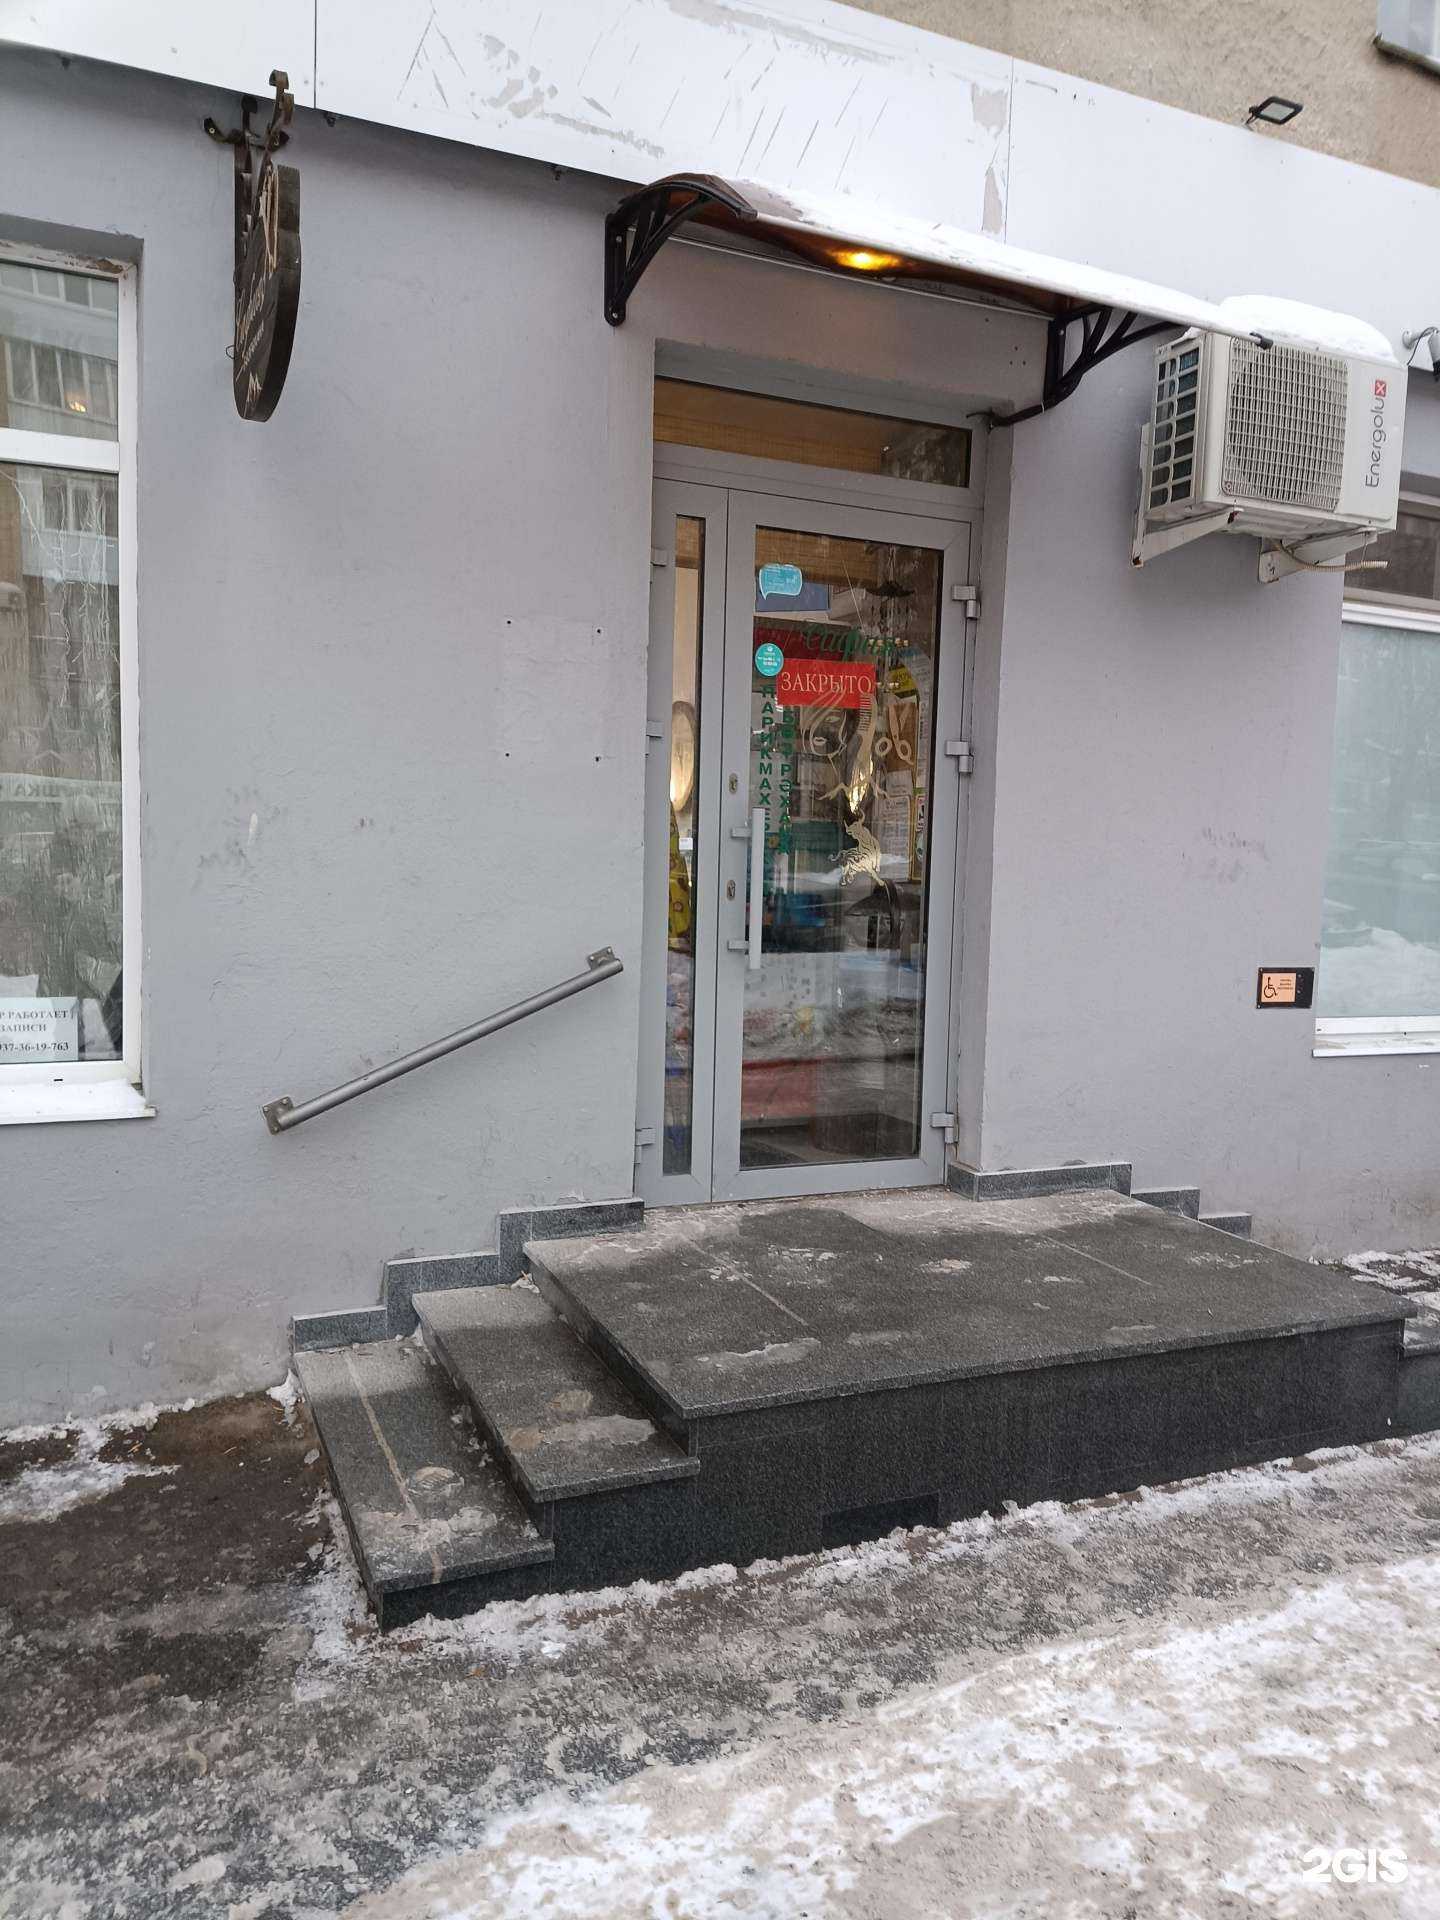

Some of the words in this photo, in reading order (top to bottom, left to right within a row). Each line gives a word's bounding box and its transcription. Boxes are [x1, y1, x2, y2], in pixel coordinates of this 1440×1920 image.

[1365, 380, 1387, 488] Energolux
[781, 672, 873, 694] ЗАКРЫТО
[8, 1010, 68, 1019] РАБОТАЕТ
[1, 1024, 47, 1032] ЗАПИСИ
[0, 1041, 69, 1051] 37-36-19-763
